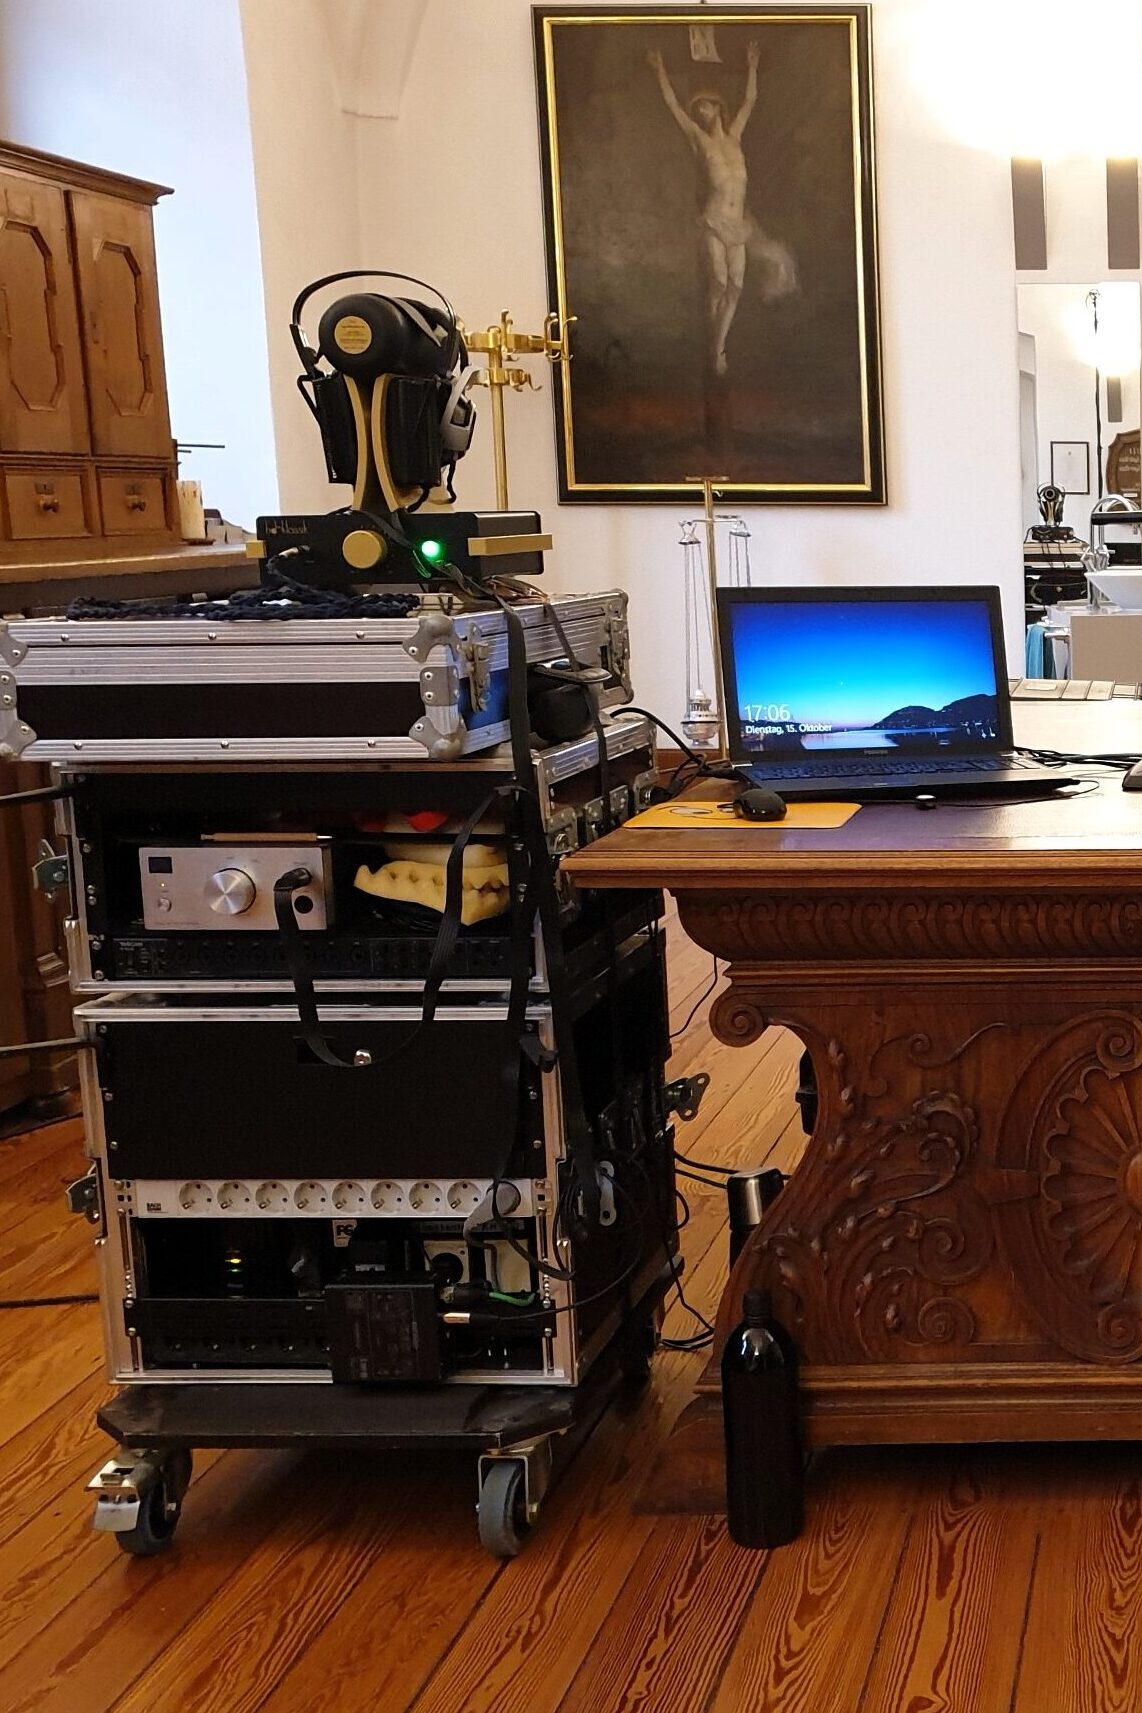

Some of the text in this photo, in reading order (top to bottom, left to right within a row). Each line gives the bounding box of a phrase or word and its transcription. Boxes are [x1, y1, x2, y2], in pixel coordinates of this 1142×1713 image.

[744, 704, 791, 722] 17:06
[745, 723, 832, 736] Dienstag, 15. Oktober
